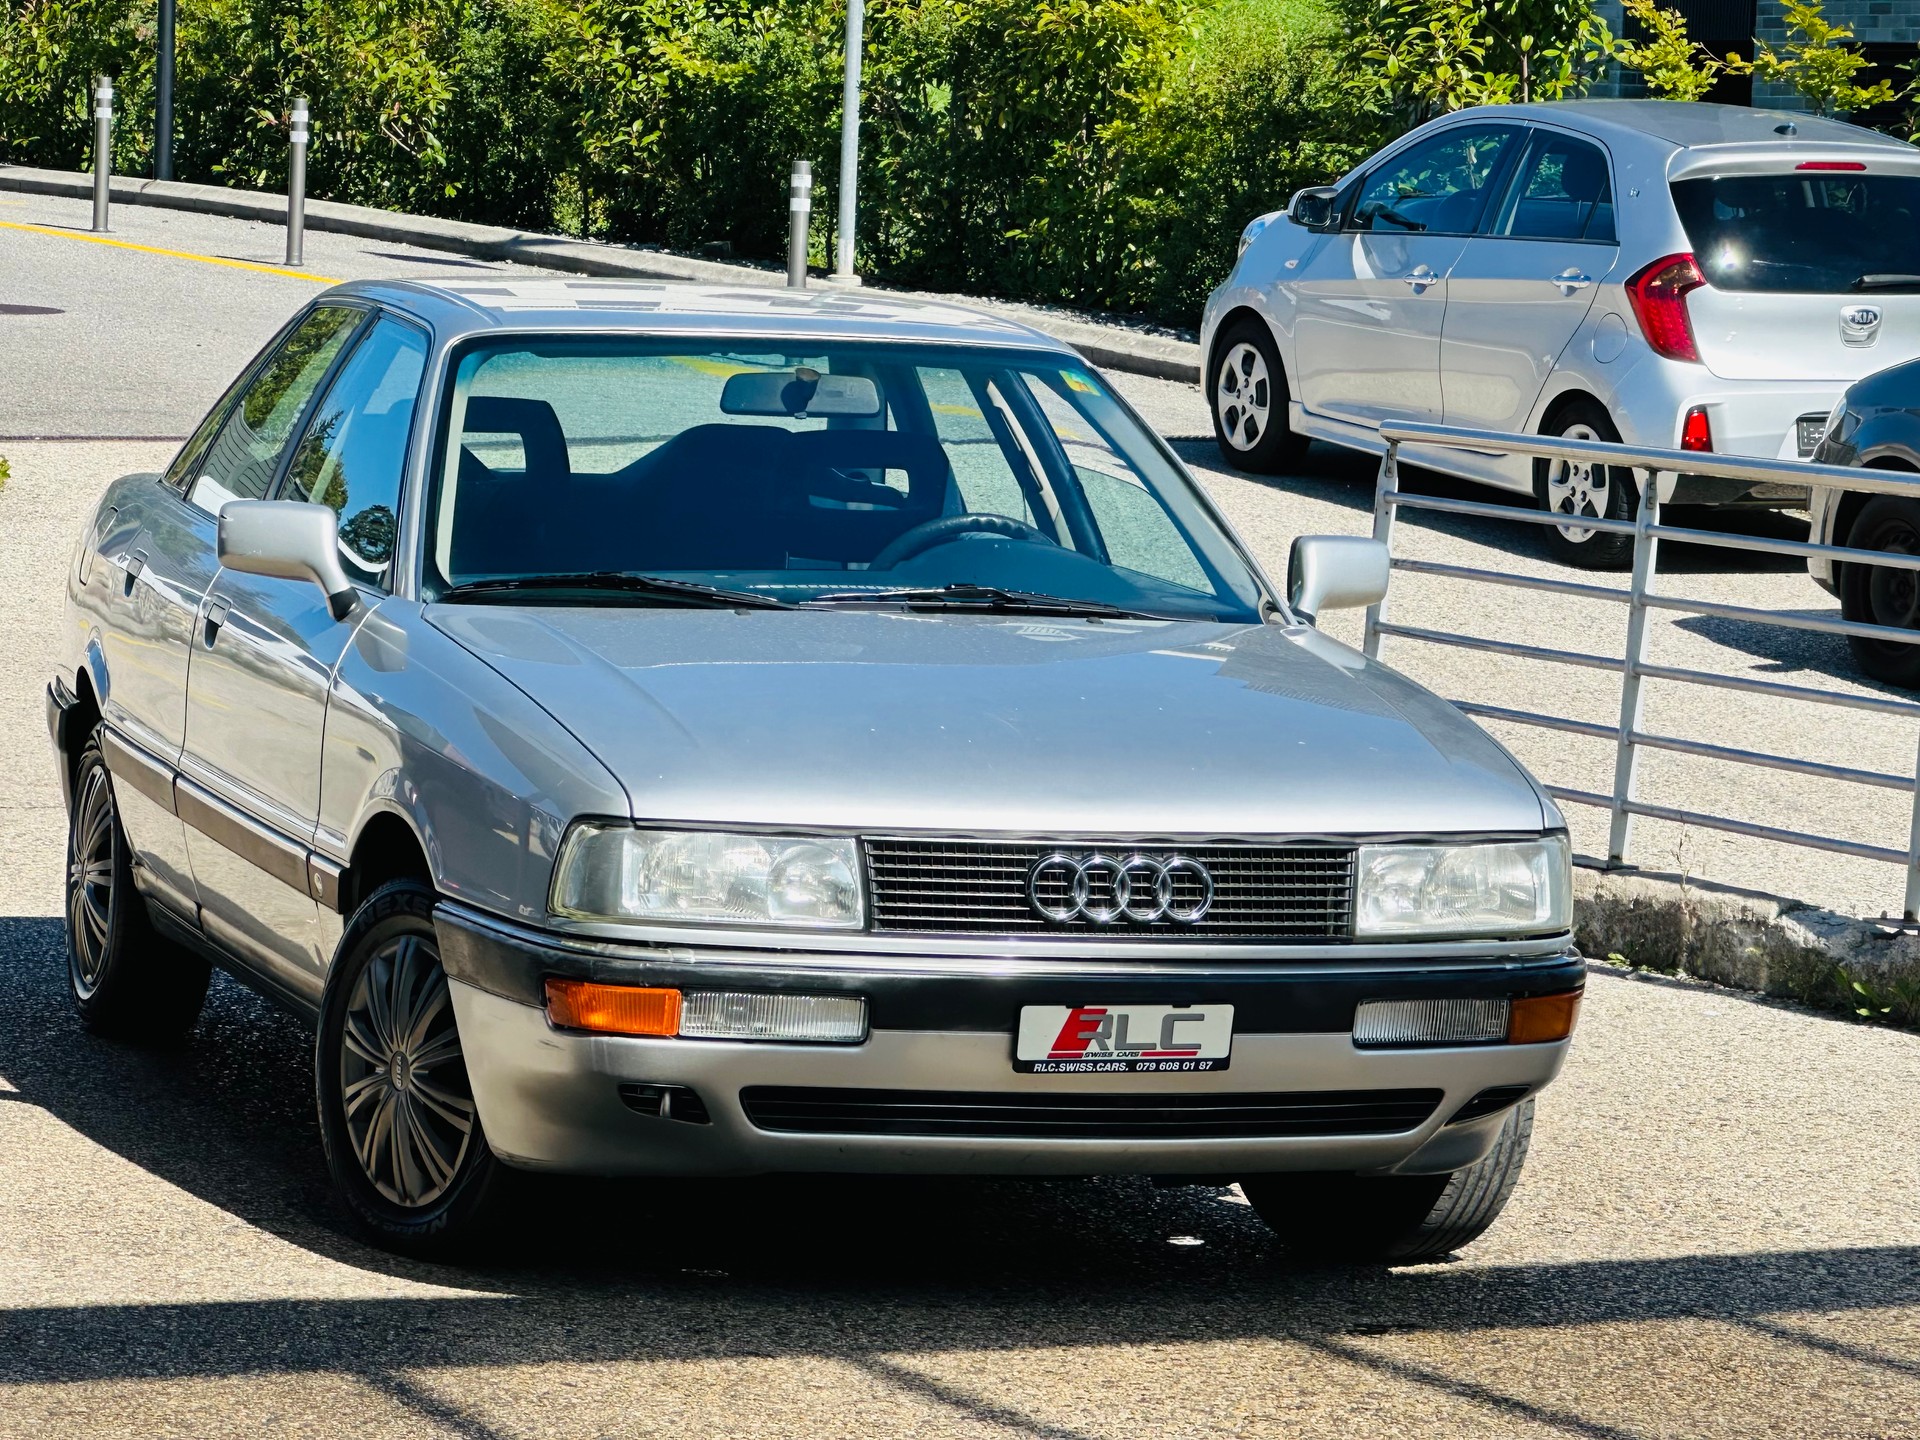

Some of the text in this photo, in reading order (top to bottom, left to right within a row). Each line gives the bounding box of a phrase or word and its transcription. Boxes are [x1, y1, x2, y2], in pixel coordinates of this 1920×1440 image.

[1853, 311, 1875, 323] KIA
[358, 893, 431, 931] NEXE
[1033, 1061, 1213, 1072] RLC.SWISS.CARS. 079 608 01 87
